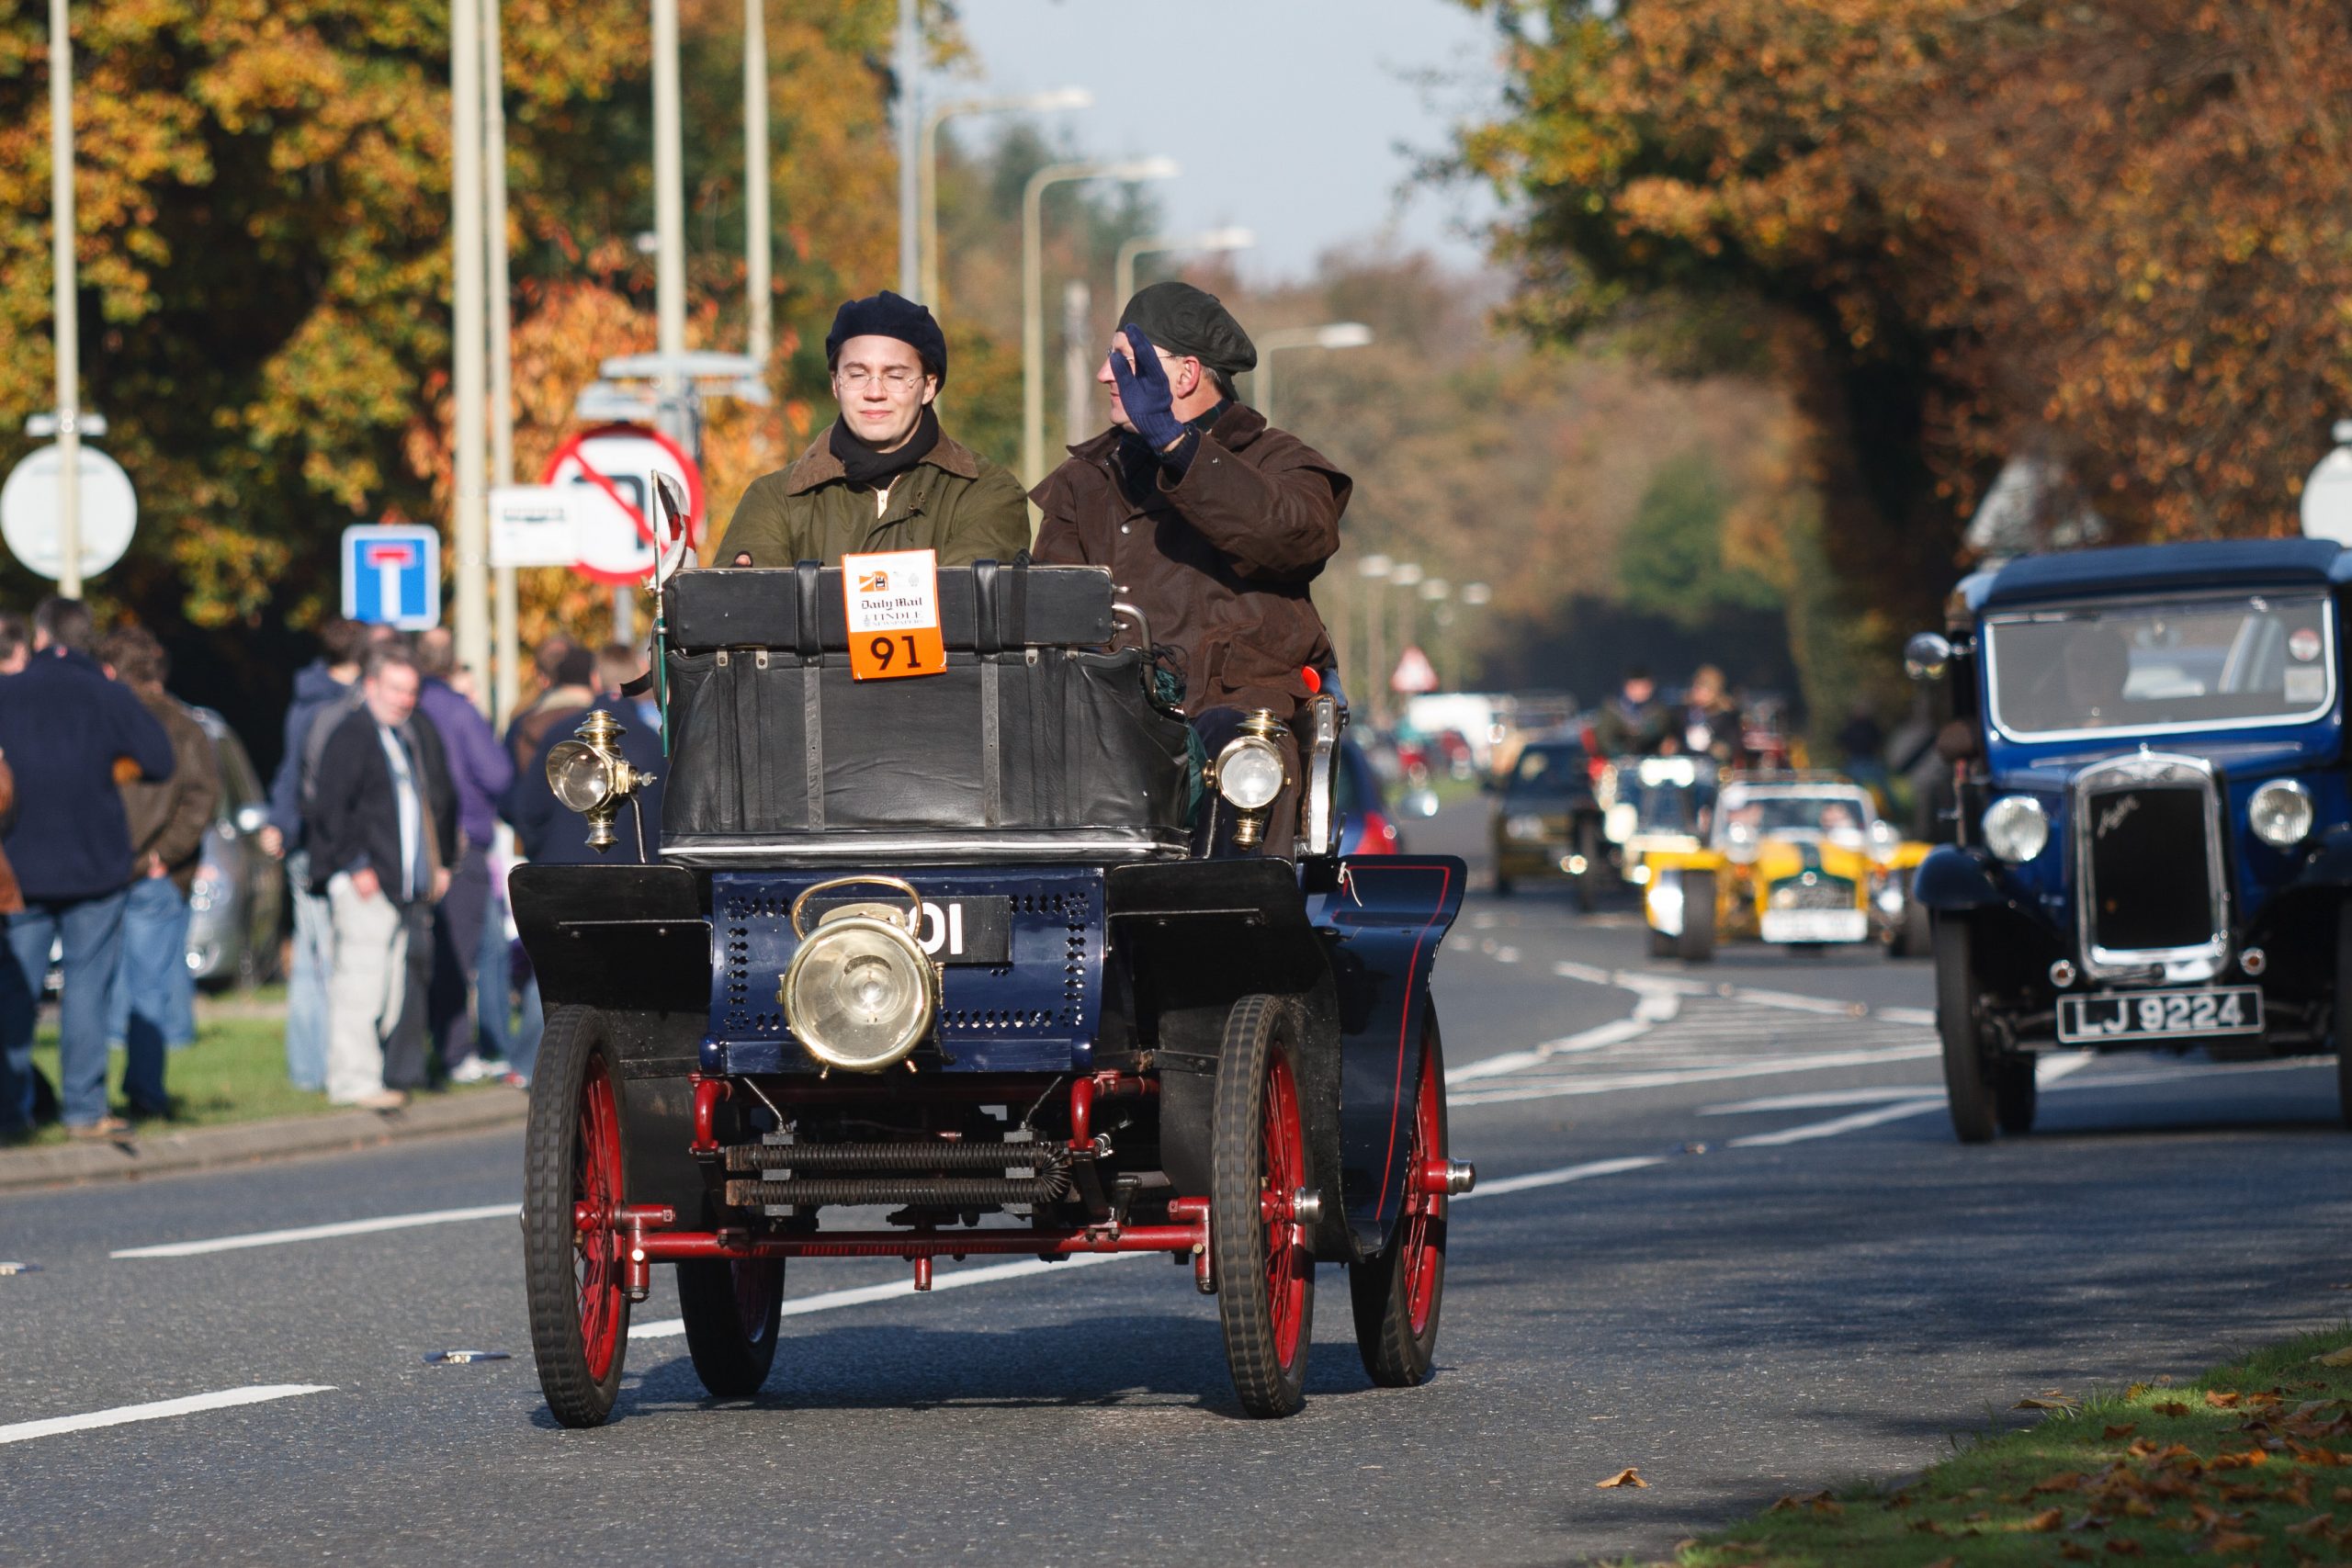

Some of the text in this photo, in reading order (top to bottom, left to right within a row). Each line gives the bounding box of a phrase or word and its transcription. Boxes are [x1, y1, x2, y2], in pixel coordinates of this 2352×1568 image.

[862, 596, 922, 611] Daily Mail
[870, 635, 922, 671] 91
[2074, 993, 2245, 1036] LJ 9224
